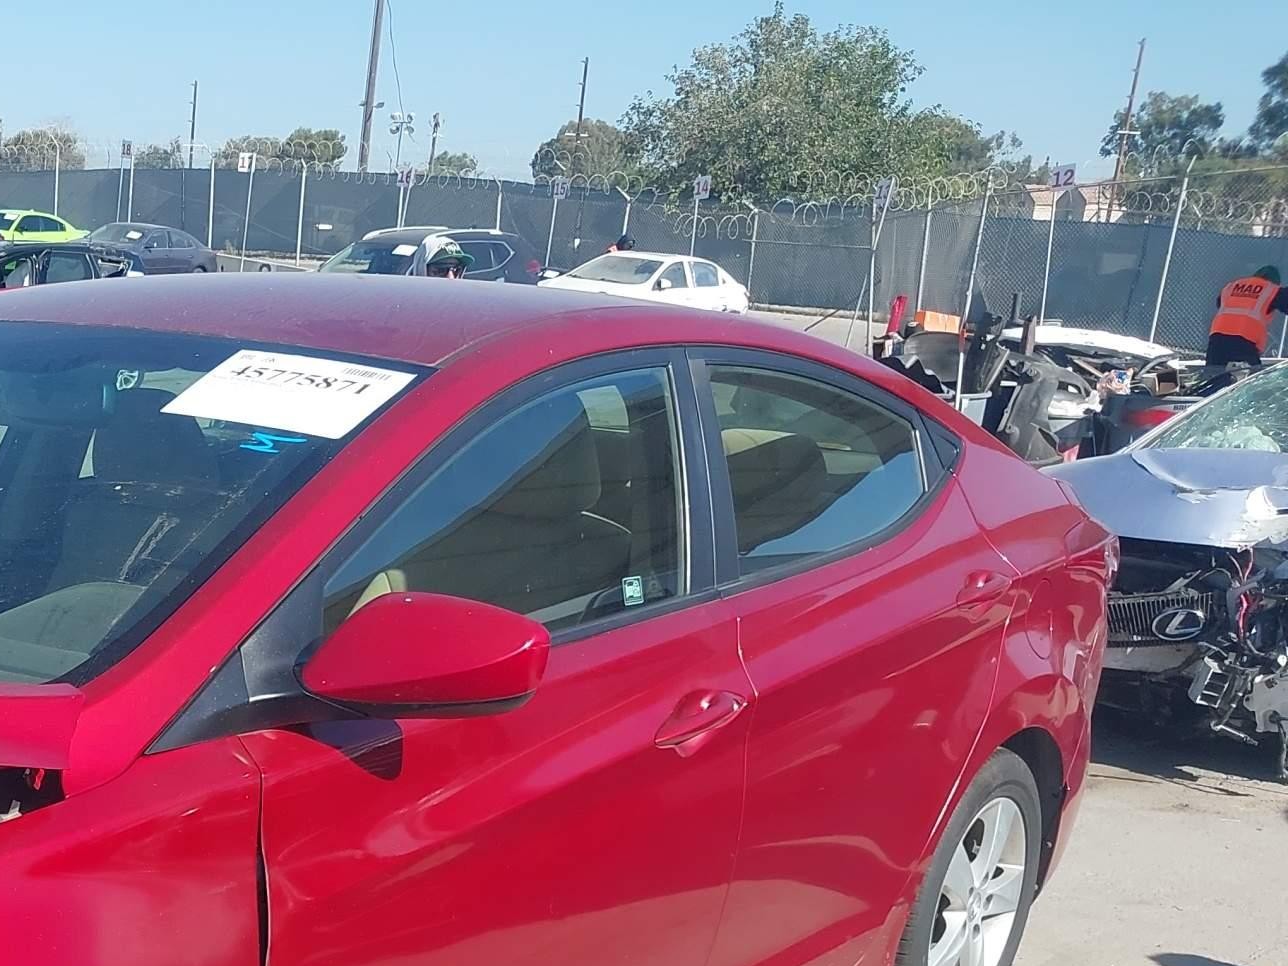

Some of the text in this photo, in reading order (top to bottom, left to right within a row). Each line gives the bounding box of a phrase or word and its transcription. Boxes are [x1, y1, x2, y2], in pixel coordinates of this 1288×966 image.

[122, 143, 131, 156] 18
[1052, 168, 1074, 188] 12
[554, 182, 567, 196] 15
[695, 182, 708, 195] 14
[1232, 283, 1264, 294] MAD
[230, 365, 371, 394] 45775871
